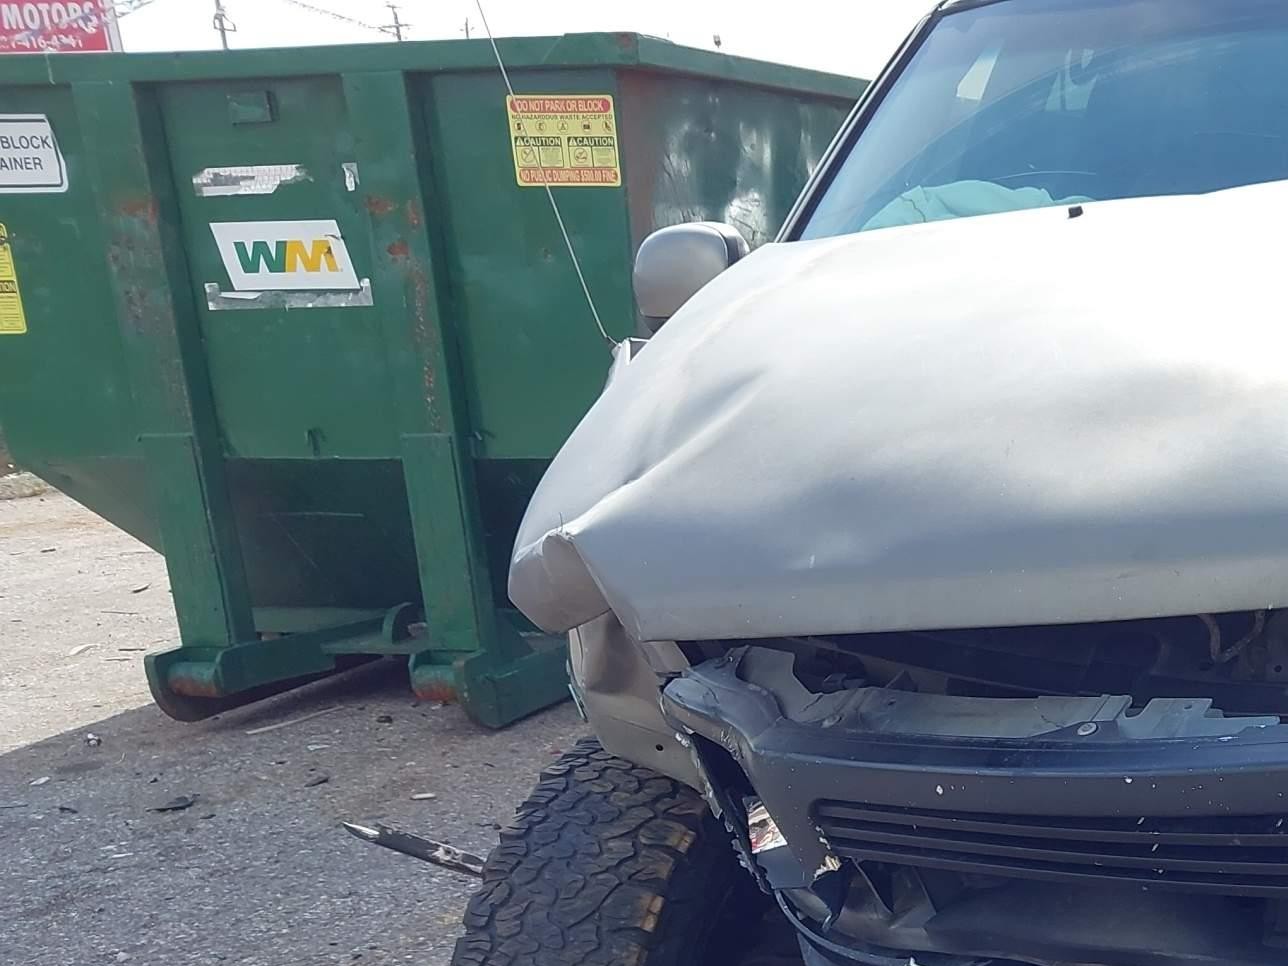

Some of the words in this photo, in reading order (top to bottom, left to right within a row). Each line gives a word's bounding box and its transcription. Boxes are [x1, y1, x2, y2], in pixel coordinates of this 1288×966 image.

[1, 2, 97, 33] MOTORS
[529, 100, 544, 111] NOT
[545, 100, 565, 111] PARK
[566, 100, 578, 111] OR
[578, 100, 604, 111] BLOCK
[0, 135, 52, 149] BLOCK
[524, 137, 560, 146] CAUTION
[576, 137, 613, 146] CAUTION
[233, 239, 340, 273] WM
